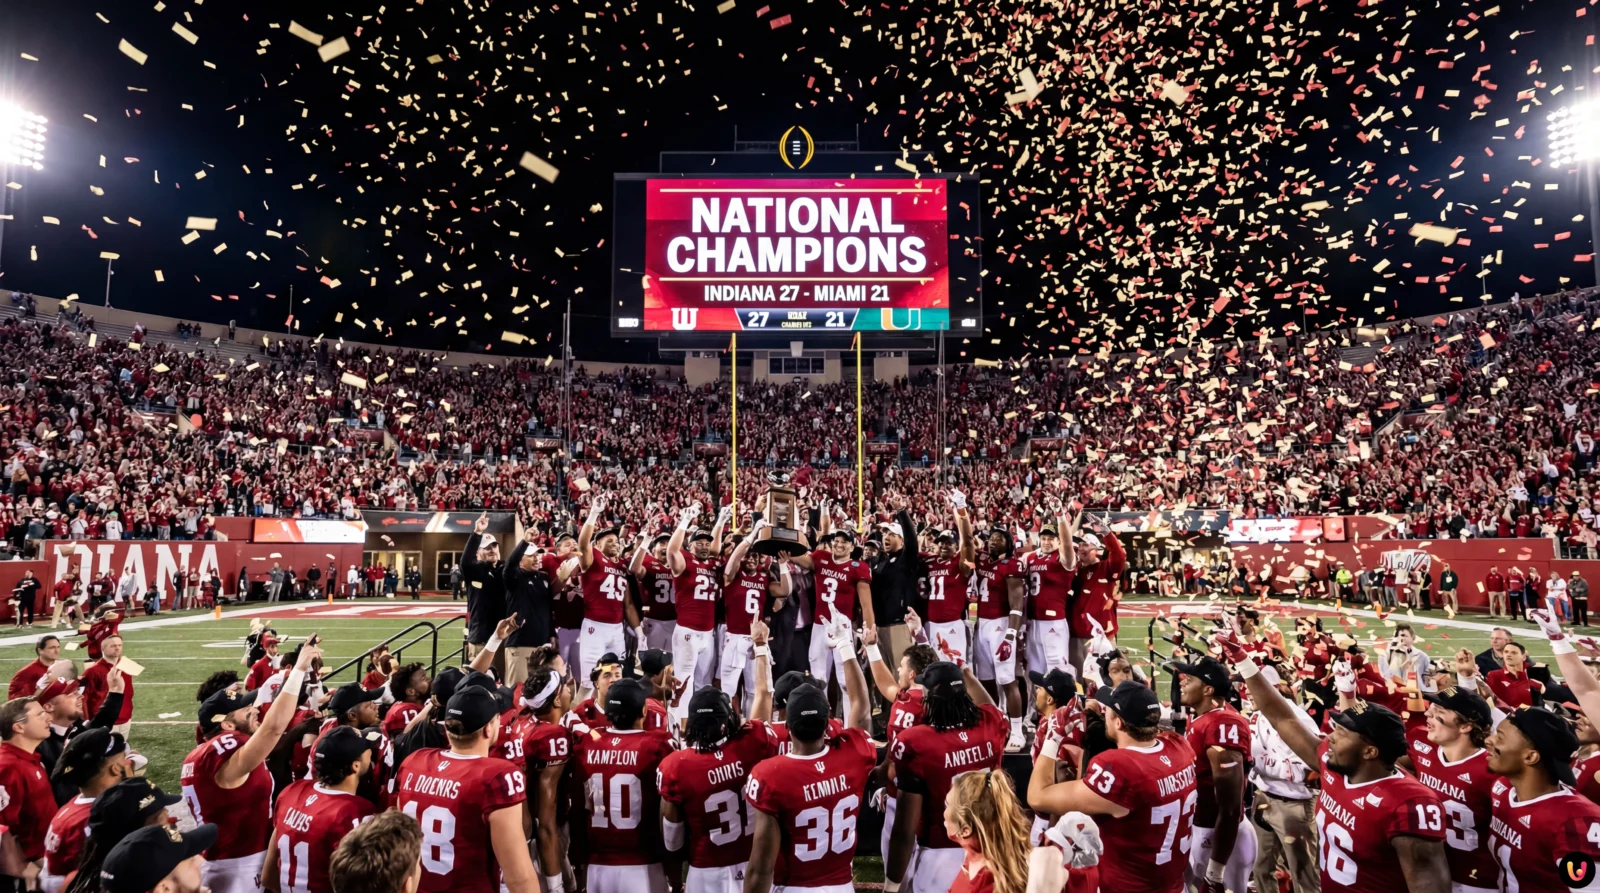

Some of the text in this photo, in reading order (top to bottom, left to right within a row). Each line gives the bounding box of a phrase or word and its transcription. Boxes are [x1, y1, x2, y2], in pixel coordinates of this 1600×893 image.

[691, 197, 905, 233] NATIONAL
[666, 236, 927, 274] CHAMPIONS
[704, 285, 775, 301] INDIANA
[779, 285, 799, 301] 27
[814, 285, 866, 301] MIAMI
[870, 285, 890, 301] 21
[748, 311, 769, 327] 27
[825, 311, 846, 327] 21
[821, 577, 838, 602] 3
[929, 576, 945, 600] 11
[745, 588, 760, 614] 6
[894, 708, 915, 729] 78
[212, 733, 238, 755] 15
[1219, 723, 1239, 744] 14
[549, 737, 568, 756] 13
[586, 749, 638, 766] KAMPLON
[1087, 763, 1116, 794] 73
[1419, 771, 1467, 802] INDIANA
[590, 772, 642, 830] 10
[1319, 789, 1356, 831] INDIANA
[794, 793, 859, 863] 36
[1415, 803, 1442, 831] 13
[277, 833, 312, 893] 11
